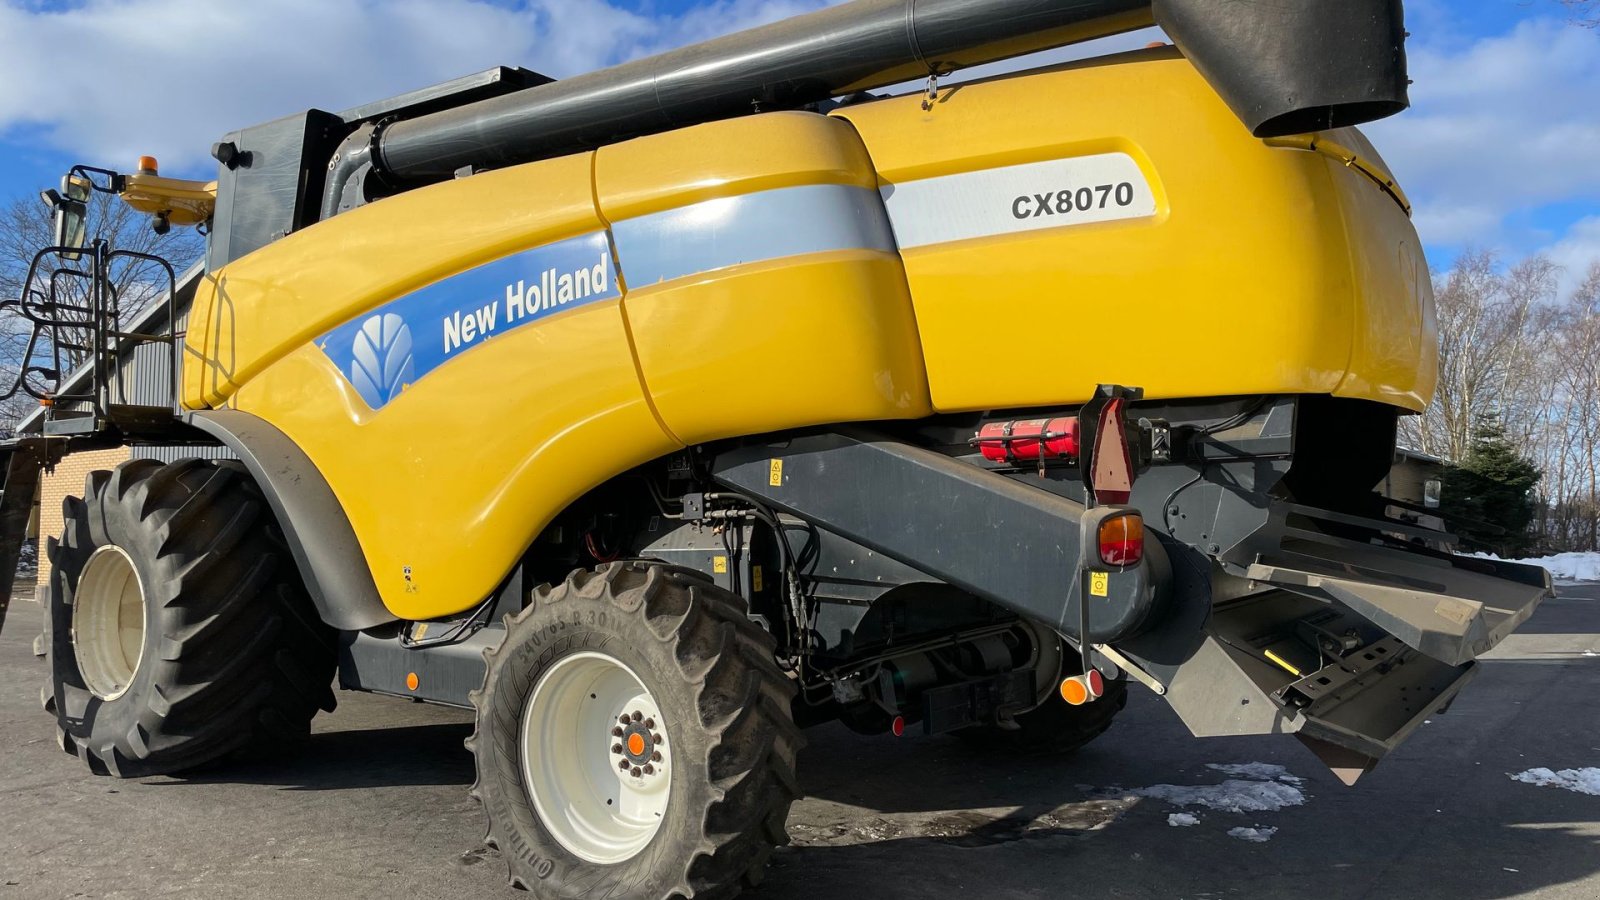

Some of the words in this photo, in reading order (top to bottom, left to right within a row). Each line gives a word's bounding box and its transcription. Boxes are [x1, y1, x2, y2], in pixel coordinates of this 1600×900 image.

[1012, 182, 1134, 219] CX8070
[443, 300, 498, 354] New
[506, 252, 608, 323] Holland
